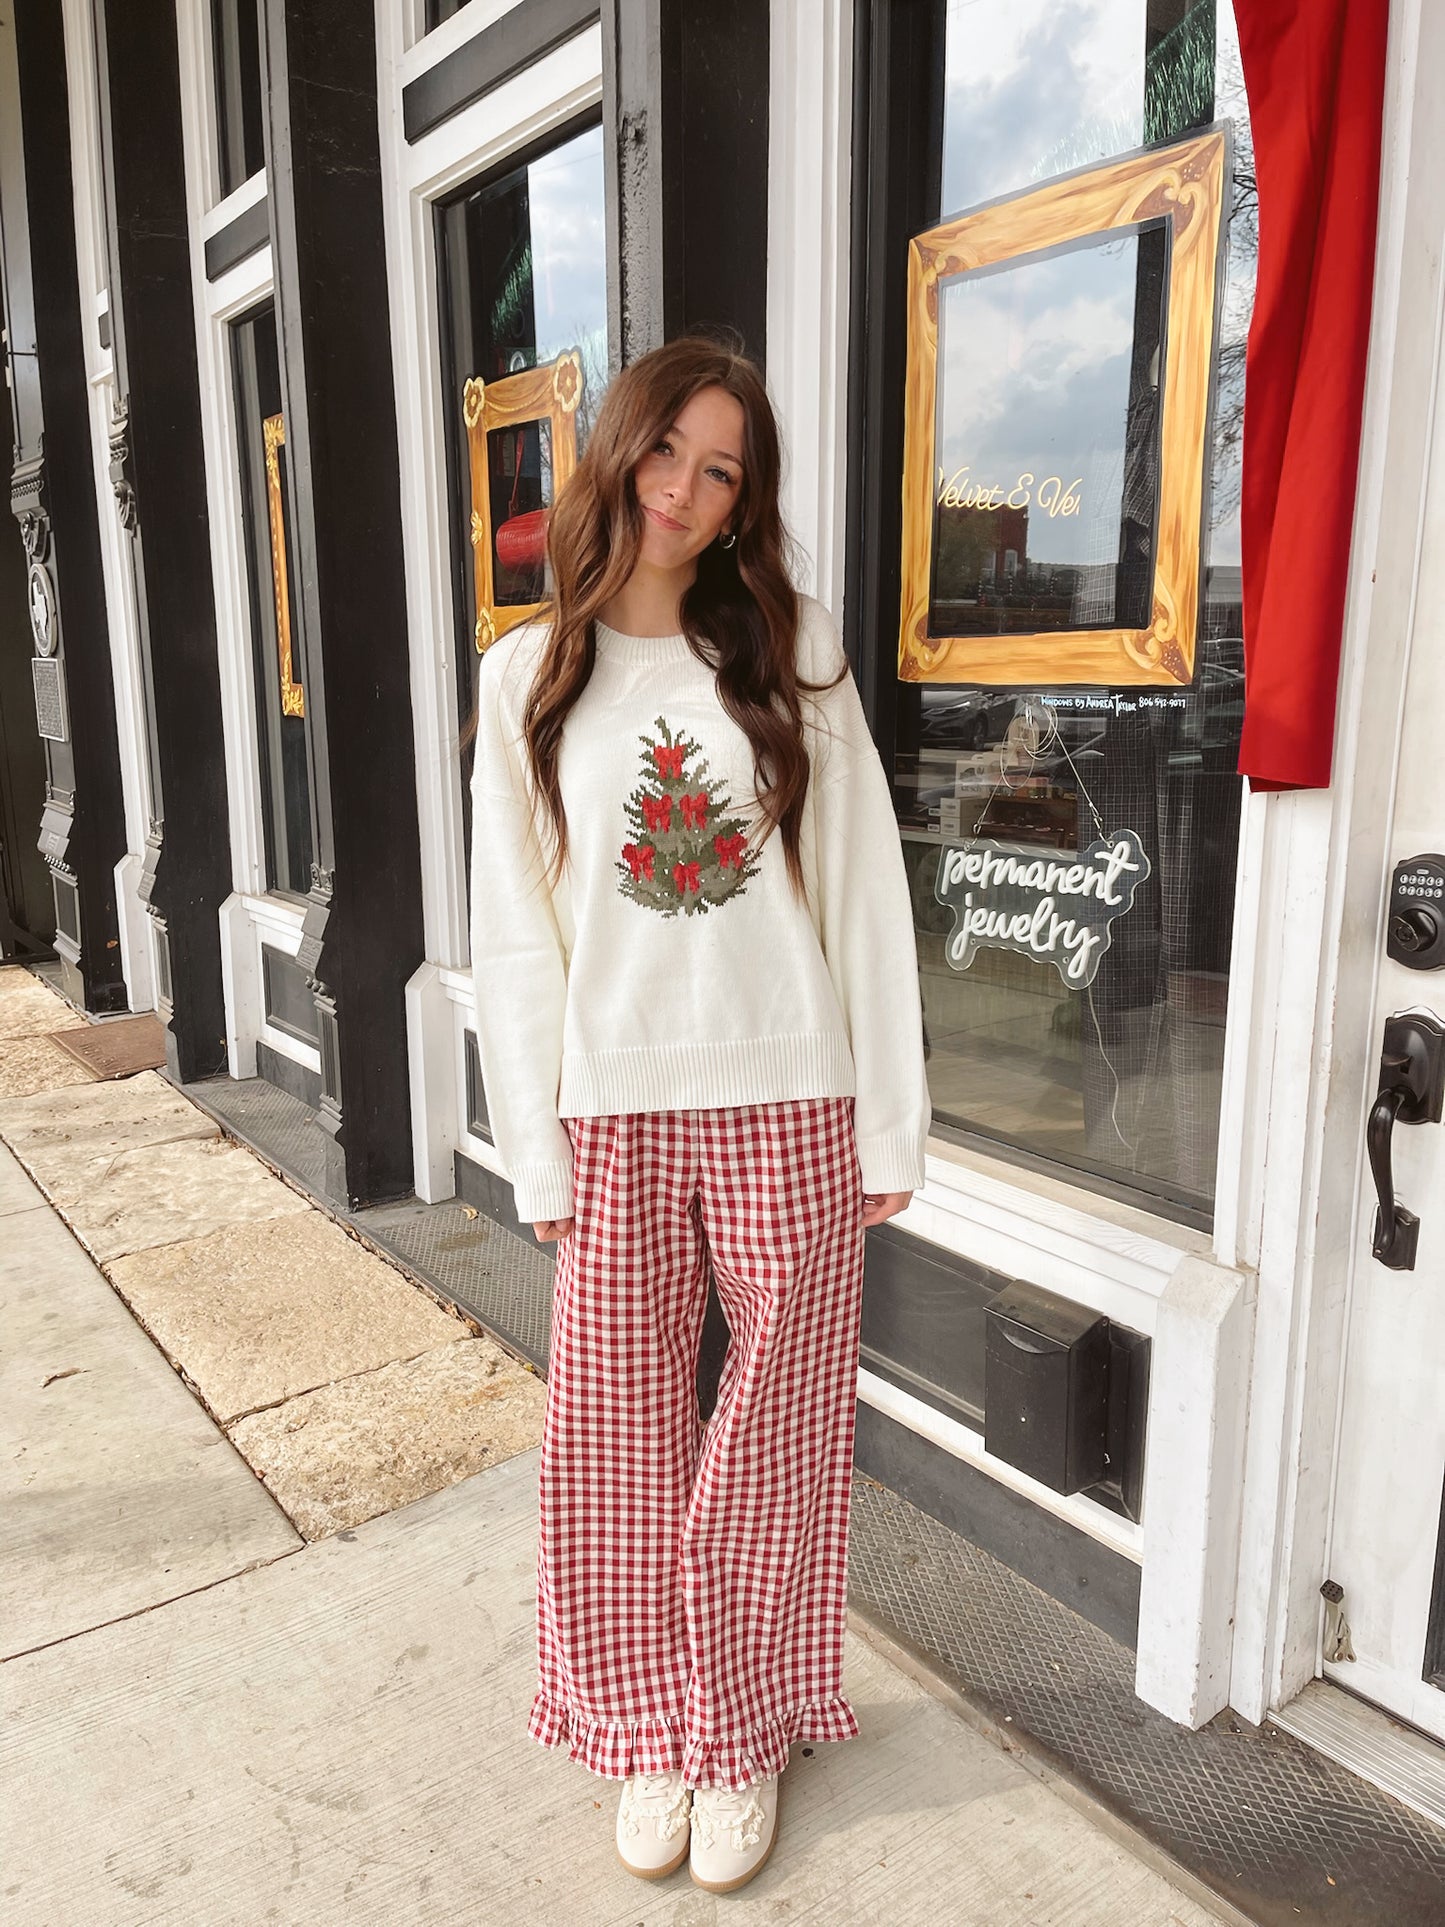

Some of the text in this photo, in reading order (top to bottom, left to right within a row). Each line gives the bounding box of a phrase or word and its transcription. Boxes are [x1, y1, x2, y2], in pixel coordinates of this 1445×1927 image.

[937, 466, 1004, 511] Velvet
[1138, 696, 1153, 708] 806
[941, 841, 1139, 906] permanent
[951, 892, 1101, 979] jewelry
